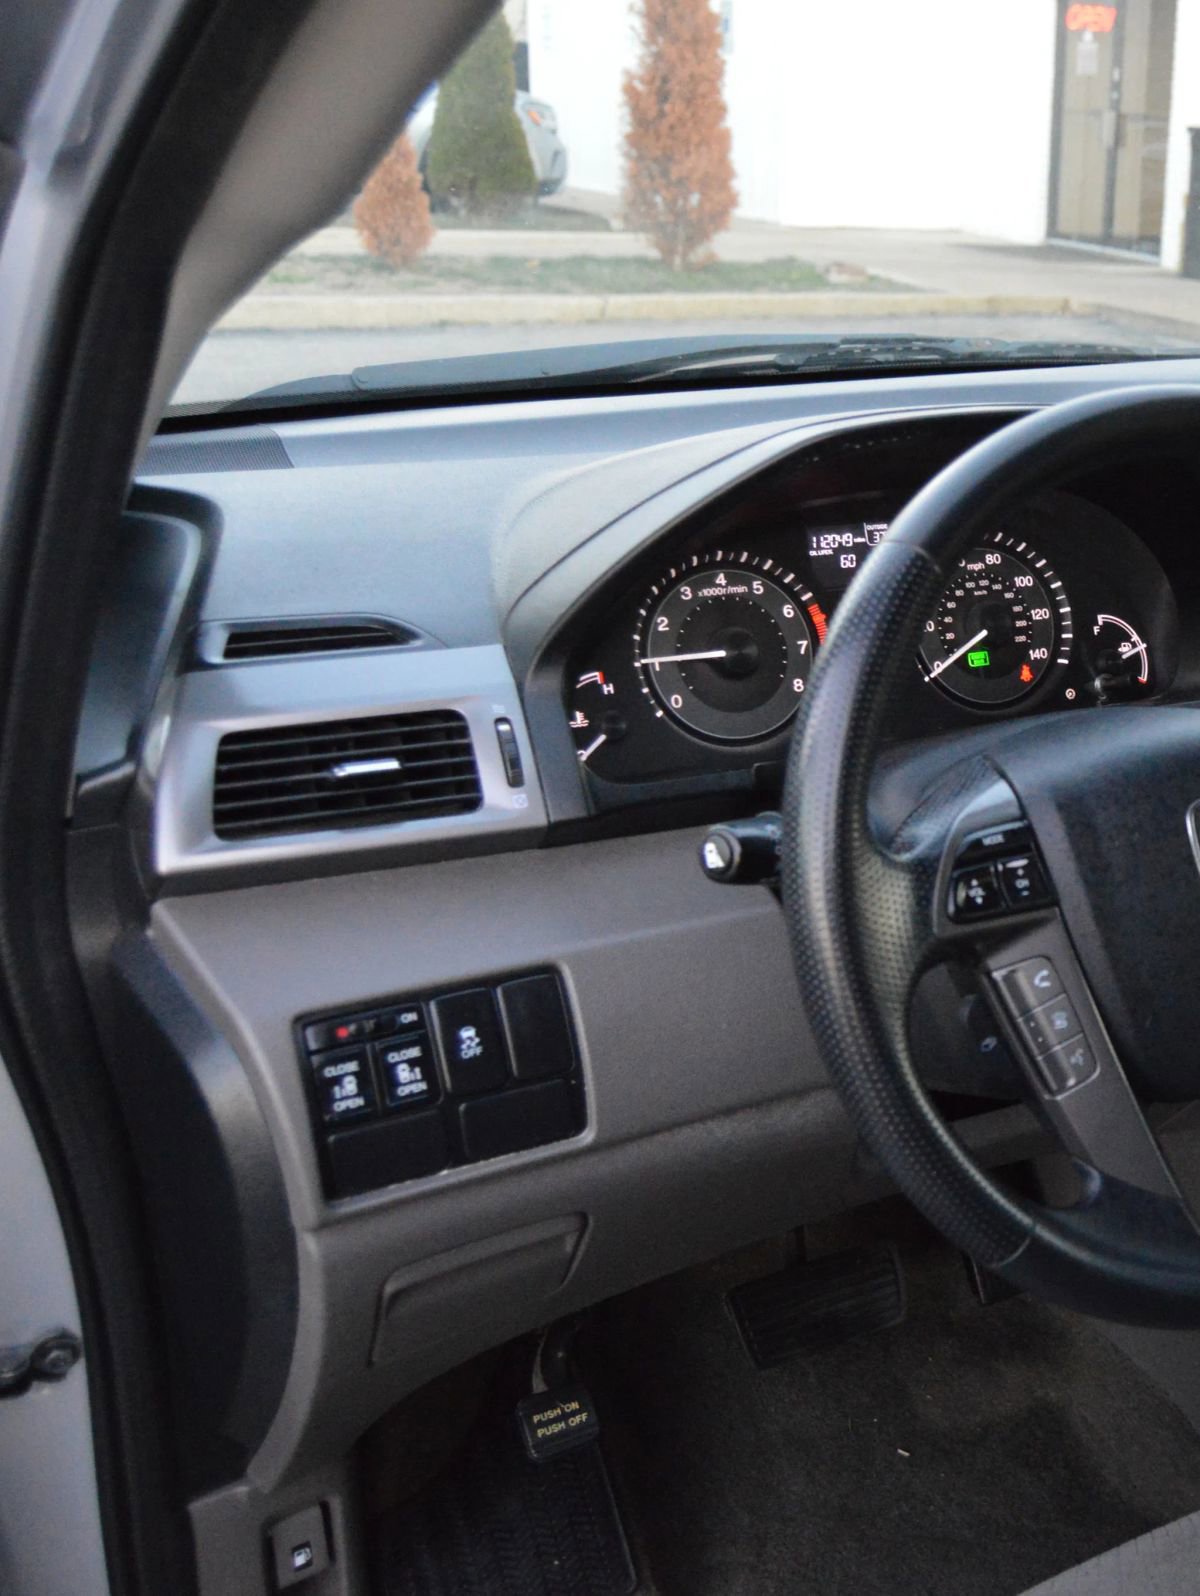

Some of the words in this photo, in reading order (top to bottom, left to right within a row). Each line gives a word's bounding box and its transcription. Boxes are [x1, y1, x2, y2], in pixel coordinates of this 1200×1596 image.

[812, 532, 853, 549] 112049
[840, 554, 857, 568] 60
[985, 554, 1001, 564] 80
[967, 562, 985, 571] mph
[715, 573, 727, 586] 4
[1014, 576, 1034, 587] 100
[680, 587, 692, 600] 3
[753, 581, 764, 594] 5
[782, 604, 795, 618] 6
[1030, 608, 1050, 620] 120
[656, 617, 670, 631] 2
[1093, 626, 1101, 636] F
[796, 640, 808, 655] 7
[1029, 648, 1049, 660] 140
[603, 683, 615, 694] H
[792, 678, 805, 692] 8
[670, 693, 683, 708] 0
[400, 1011, 418, 1024] ON
[387, 1046, 422, 1063] CLOSE
[461, 1045, 483, 1060] OFF
[323, 1060, 360, 1078] CLOSE
[397, 1081, 428, 1097] OPEN
[333, 1096, 365, 1112] OPEN
[533, 1407, 562, 1425] PUSH
[564, 1401, 580, 1413] ON
[536, 1420, 566, 1438] PUSH
[568, 1412, 588, 1426] OFF
